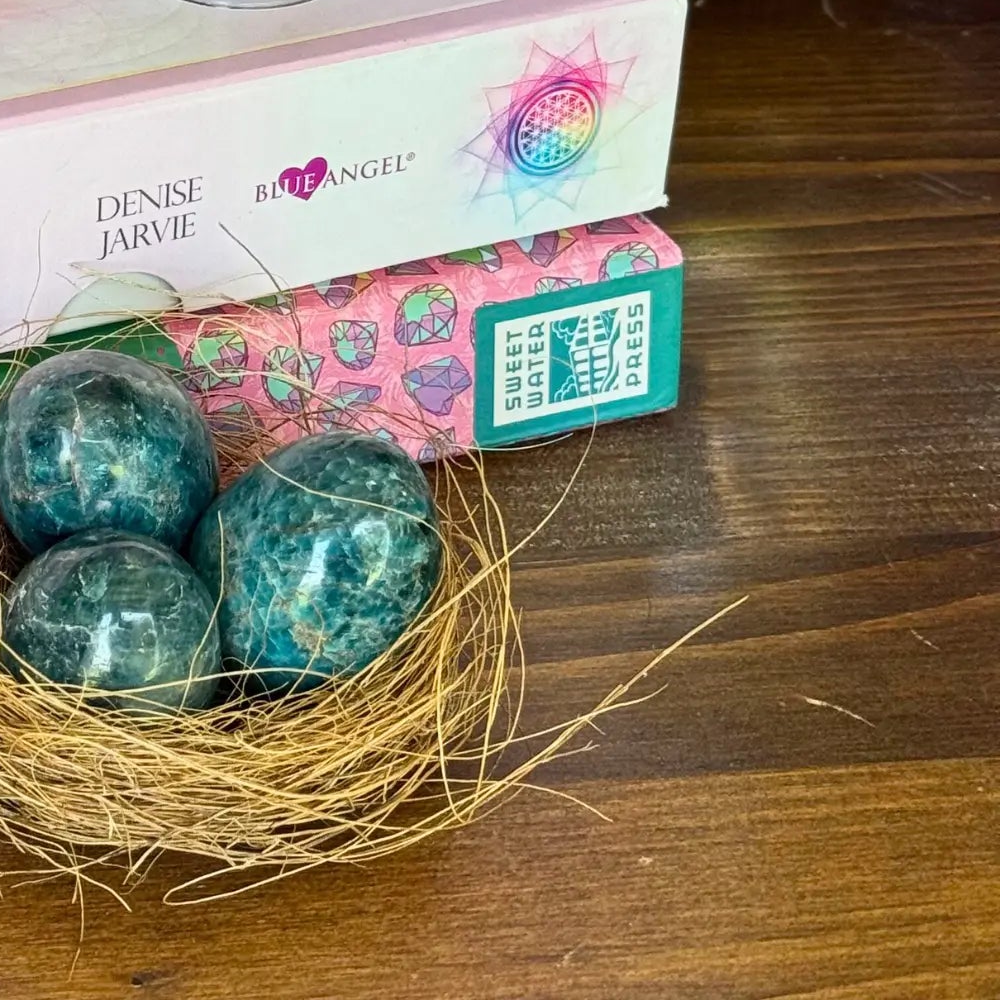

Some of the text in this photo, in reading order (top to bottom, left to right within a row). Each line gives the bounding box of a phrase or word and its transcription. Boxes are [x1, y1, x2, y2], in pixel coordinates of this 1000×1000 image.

[96, 176, 204, 223] DENISE
[97, 212, 197, 261] JARVIE
[504, 330, 523, 411] SWEET
[526, 320, 545, 409] WATER
[625, 302, 644, 388] PRESS
